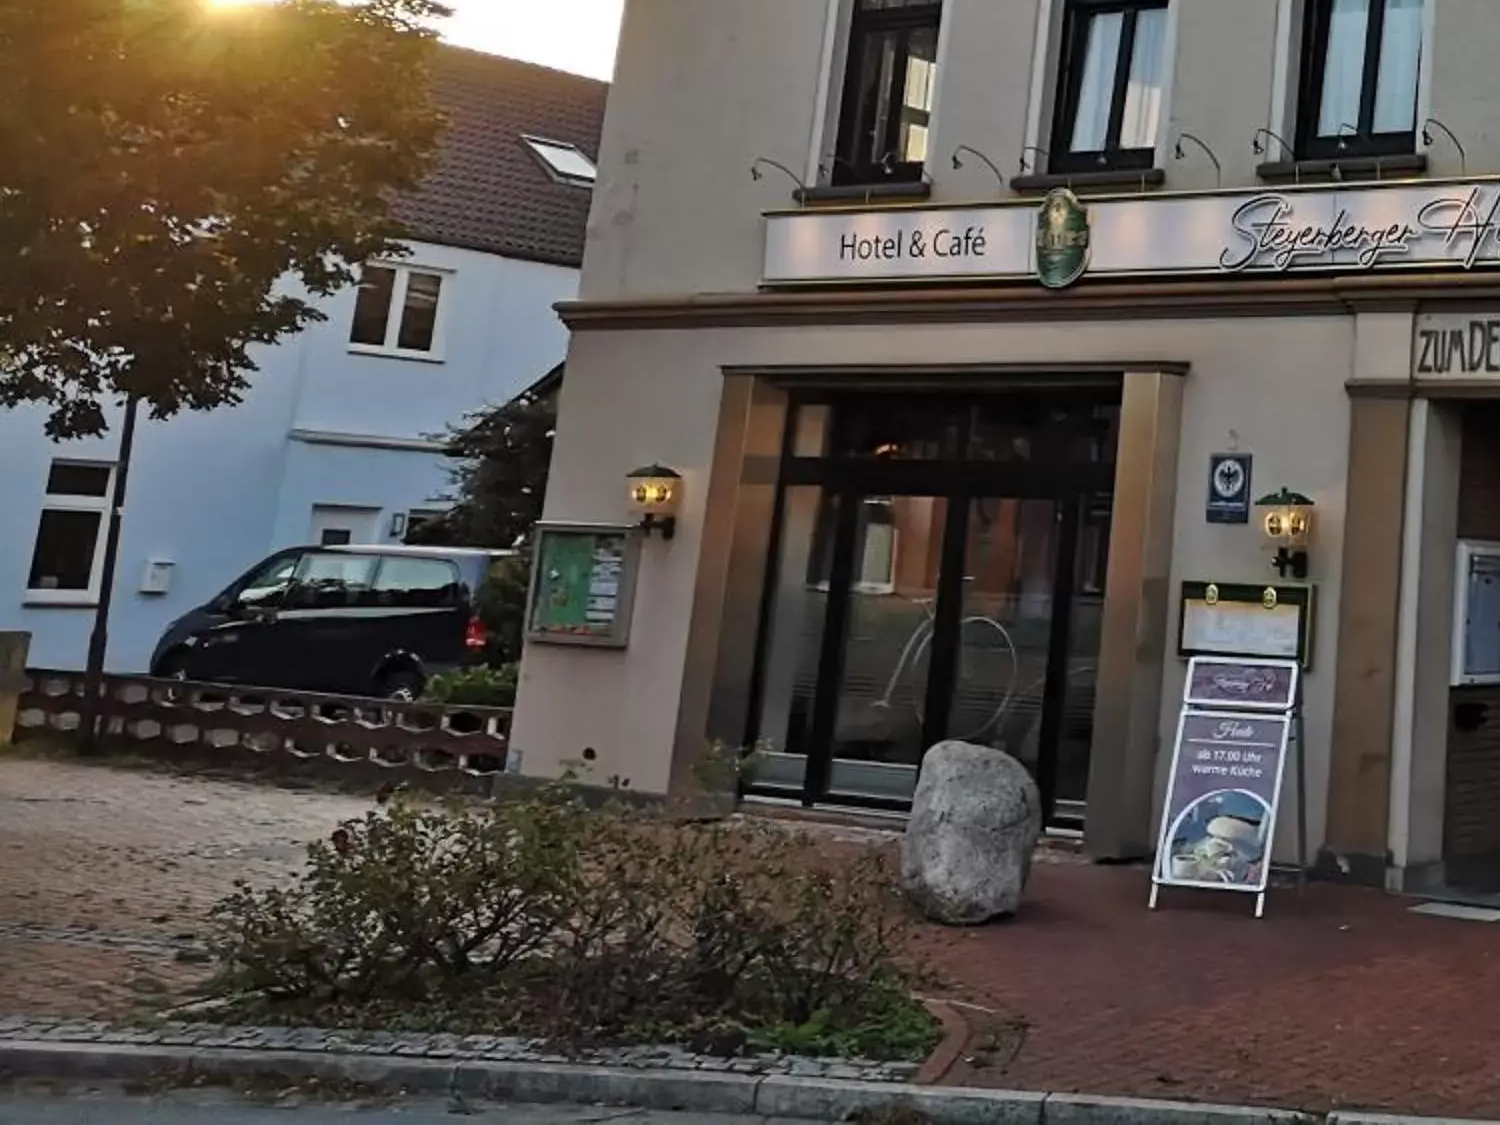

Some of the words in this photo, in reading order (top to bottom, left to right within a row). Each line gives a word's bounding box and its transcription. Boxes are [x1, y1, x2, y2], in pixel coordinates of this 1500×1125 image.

[839, 228, 902, 260] Hotel
[909, 230, 926, 258] &
[933, 227, 986, 257] Café
[1219, 195, 1418, 270] Steyerberger
[1417, 329, 1467, 373] ZUM
[1243, 750, 1262, 763] Uhr
